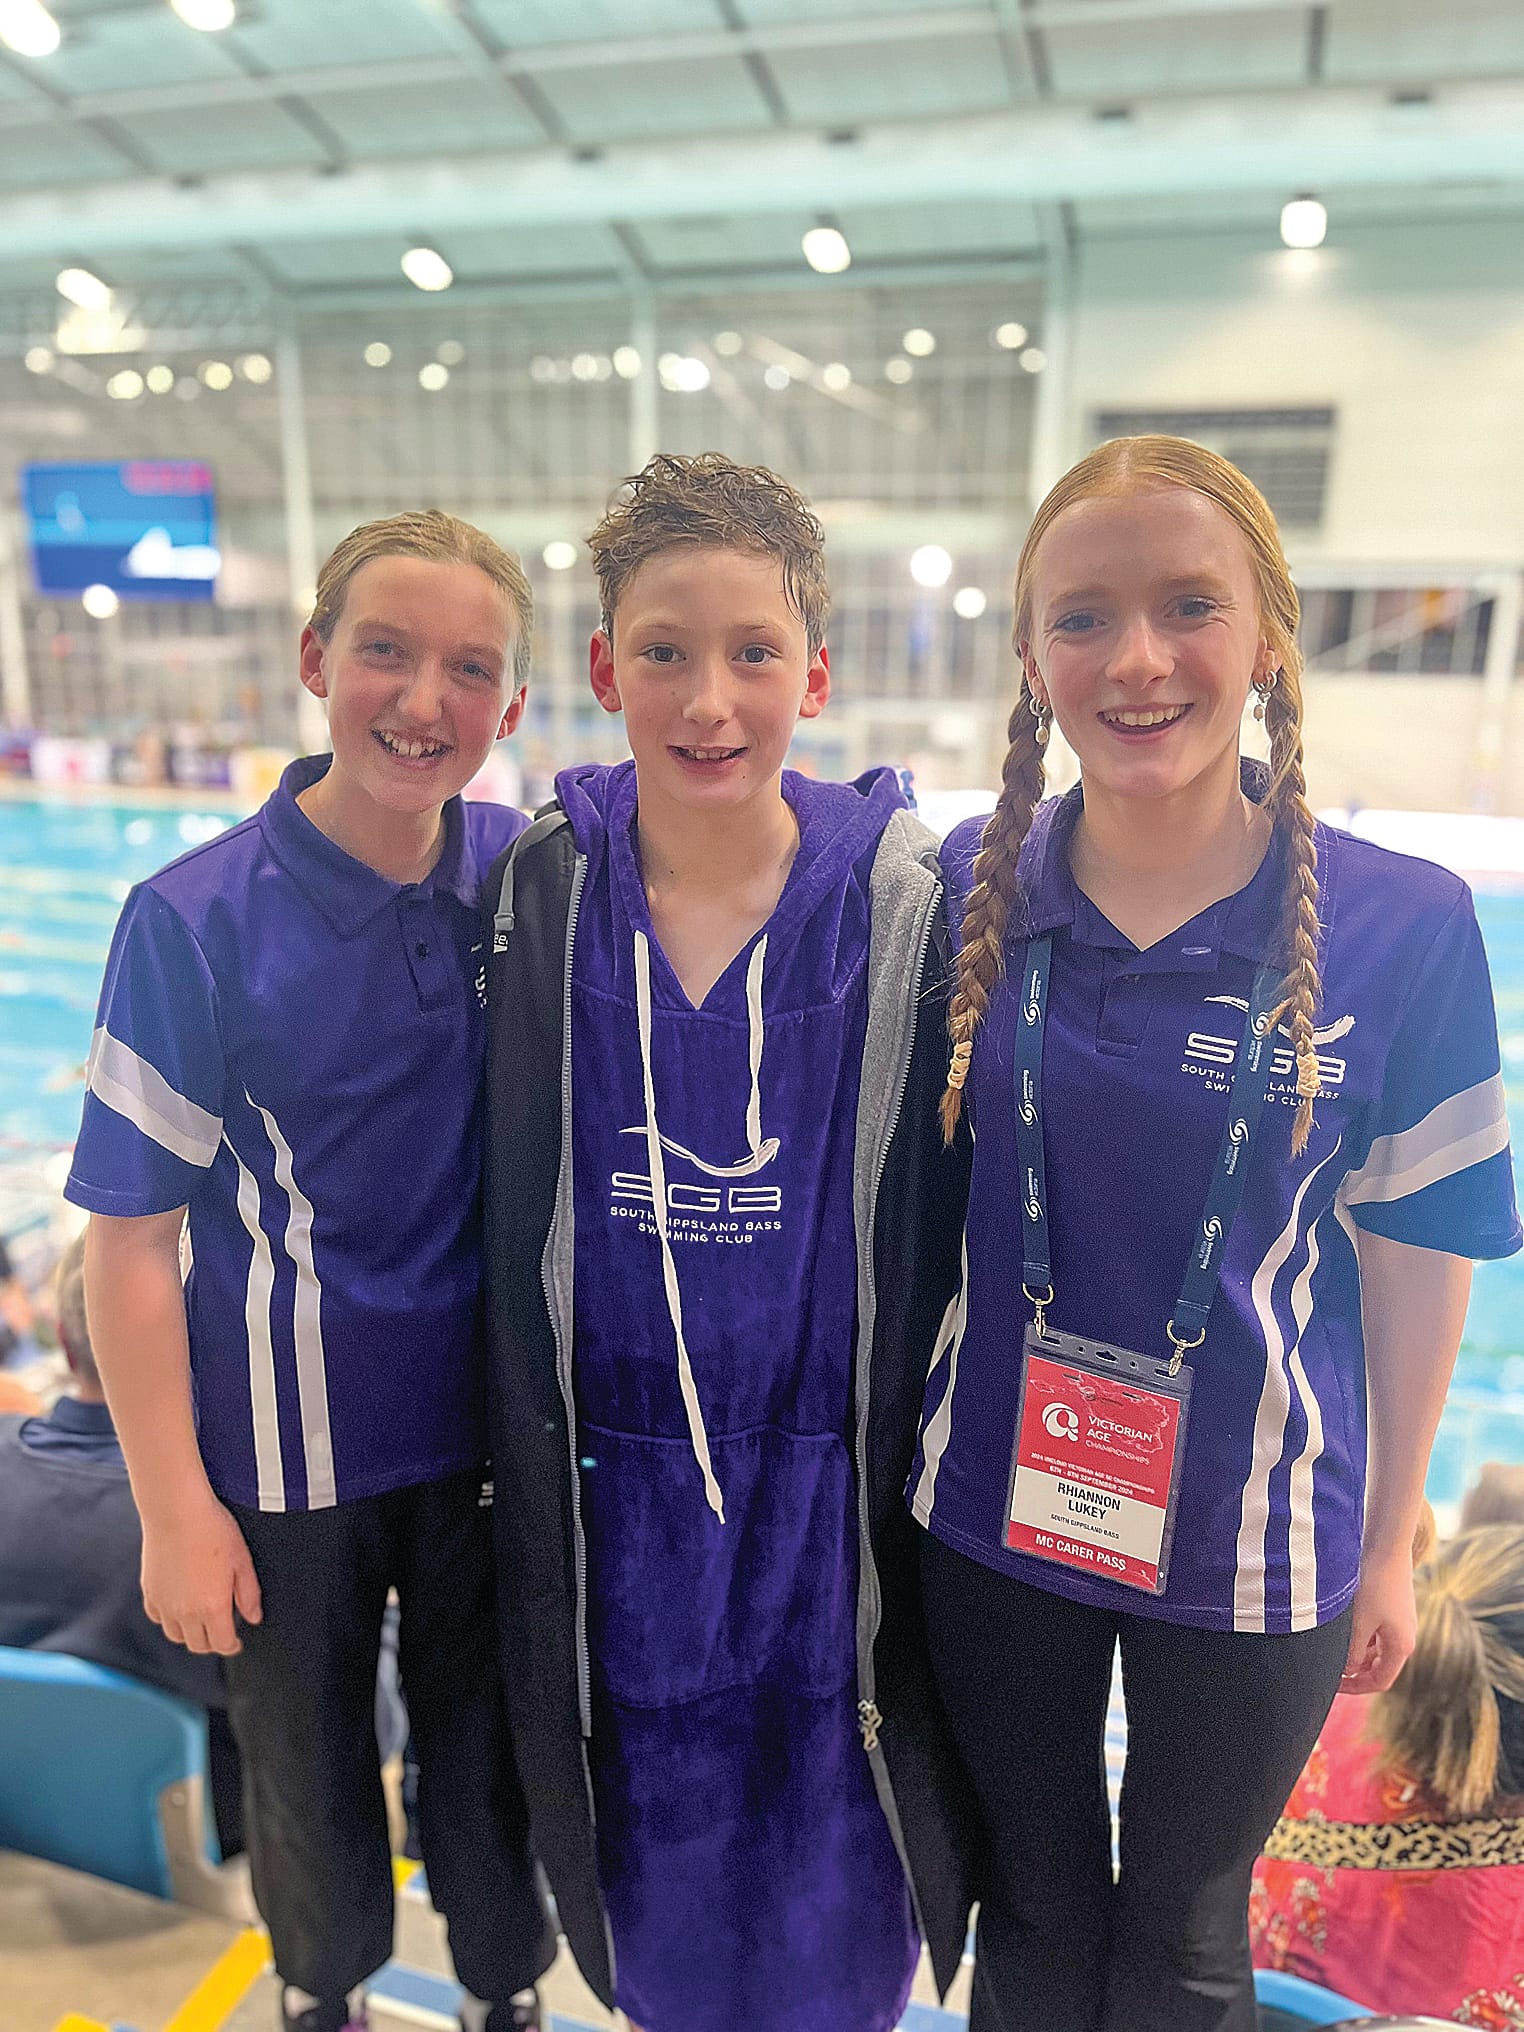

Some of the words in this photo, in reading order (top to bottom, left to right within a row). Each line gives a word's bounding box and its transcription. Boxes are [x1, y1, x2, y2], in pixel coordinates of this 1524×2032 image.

[1180, 1063, 1225, 1080] SOUTH
[1281, 1096, 1306, 1107] CLU
[665, 1217, 739, 1232] IPPSLAND
[745, 1221, 782, 1230] BASS
[716, 1234, 753, 1243] CLUB
[1086, 1428, 1112, 1443] AGE
[1088, 1415, 1153, 1442] VICTORIAN
[1085, 1440, 1150, 1465] CHAMPIONSHIPS
[1079, 1473, 1117, 1491] SEPTEMBER
[1117, 1484, 1133, 1495] 2024
[1058, 1482, 1121, 1511] RHIANNON
[1068, 1500, 1106, 1520] LUKEY
[1051, 1513, 1069, 1525] SOUTH
[1070, 1519, 1103, 1533] GIPPSLAND
[1103, 1529, 1119, 1539] BASS
[1036, 1533, 1054, 1548] MC
[1056, 1540, 1094, 1561] CARER
[1096, 1551, 1126, 1571] PASS
